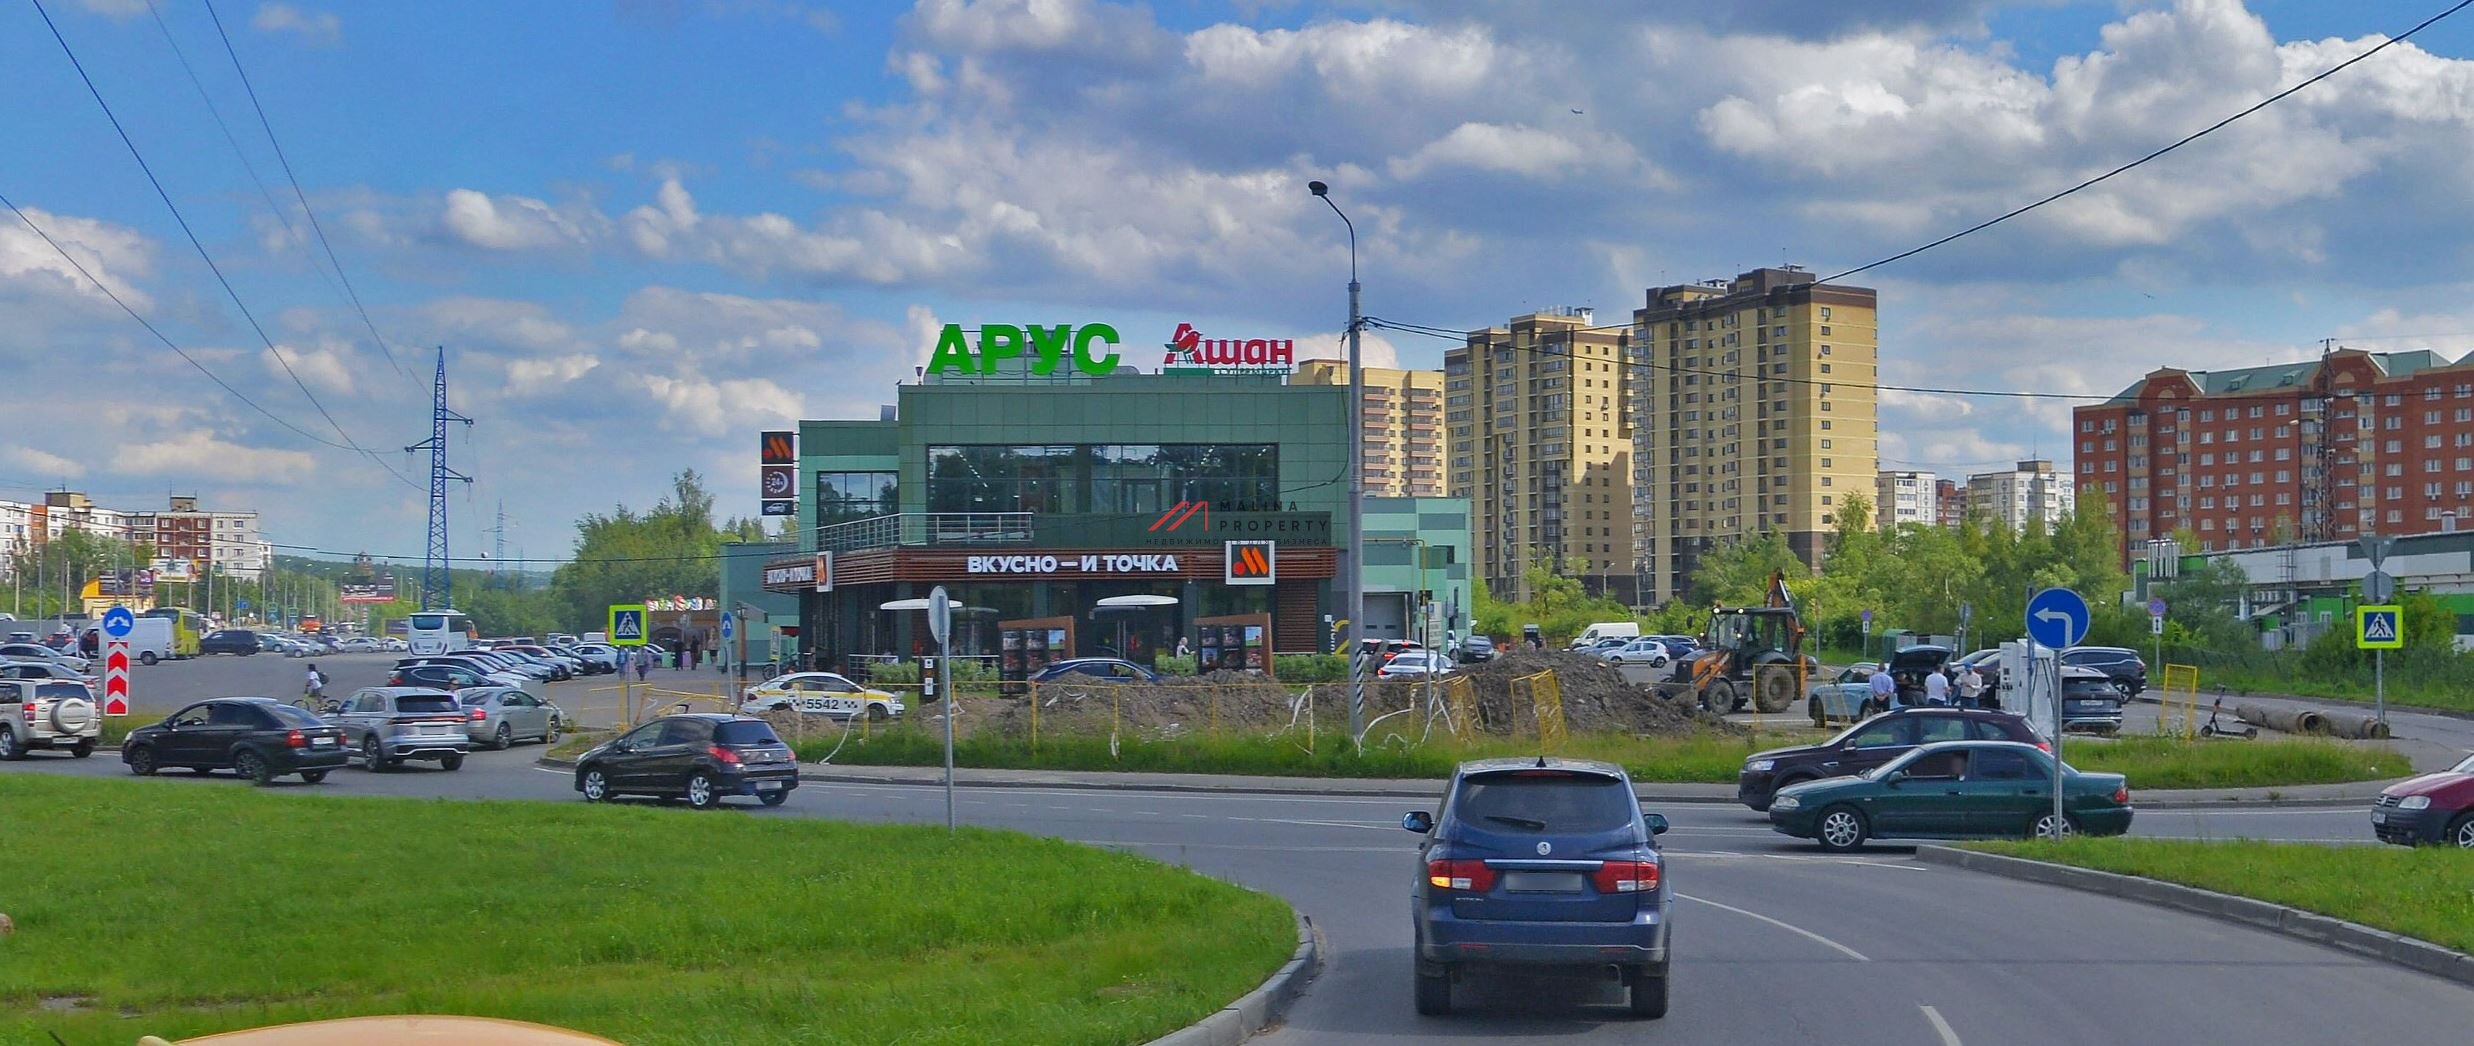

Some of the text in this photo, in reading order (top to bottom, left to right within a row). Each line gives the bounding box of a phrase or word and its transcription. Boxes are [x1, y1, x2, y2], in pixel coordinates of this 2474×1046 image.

[926, 322, 1120, 376] АРУС
[967, 555, 1057, 573] ВКУСНО
[1103, 554, 1179, 572] ТОЧКА
[806, 699, 839, 710] 5542
